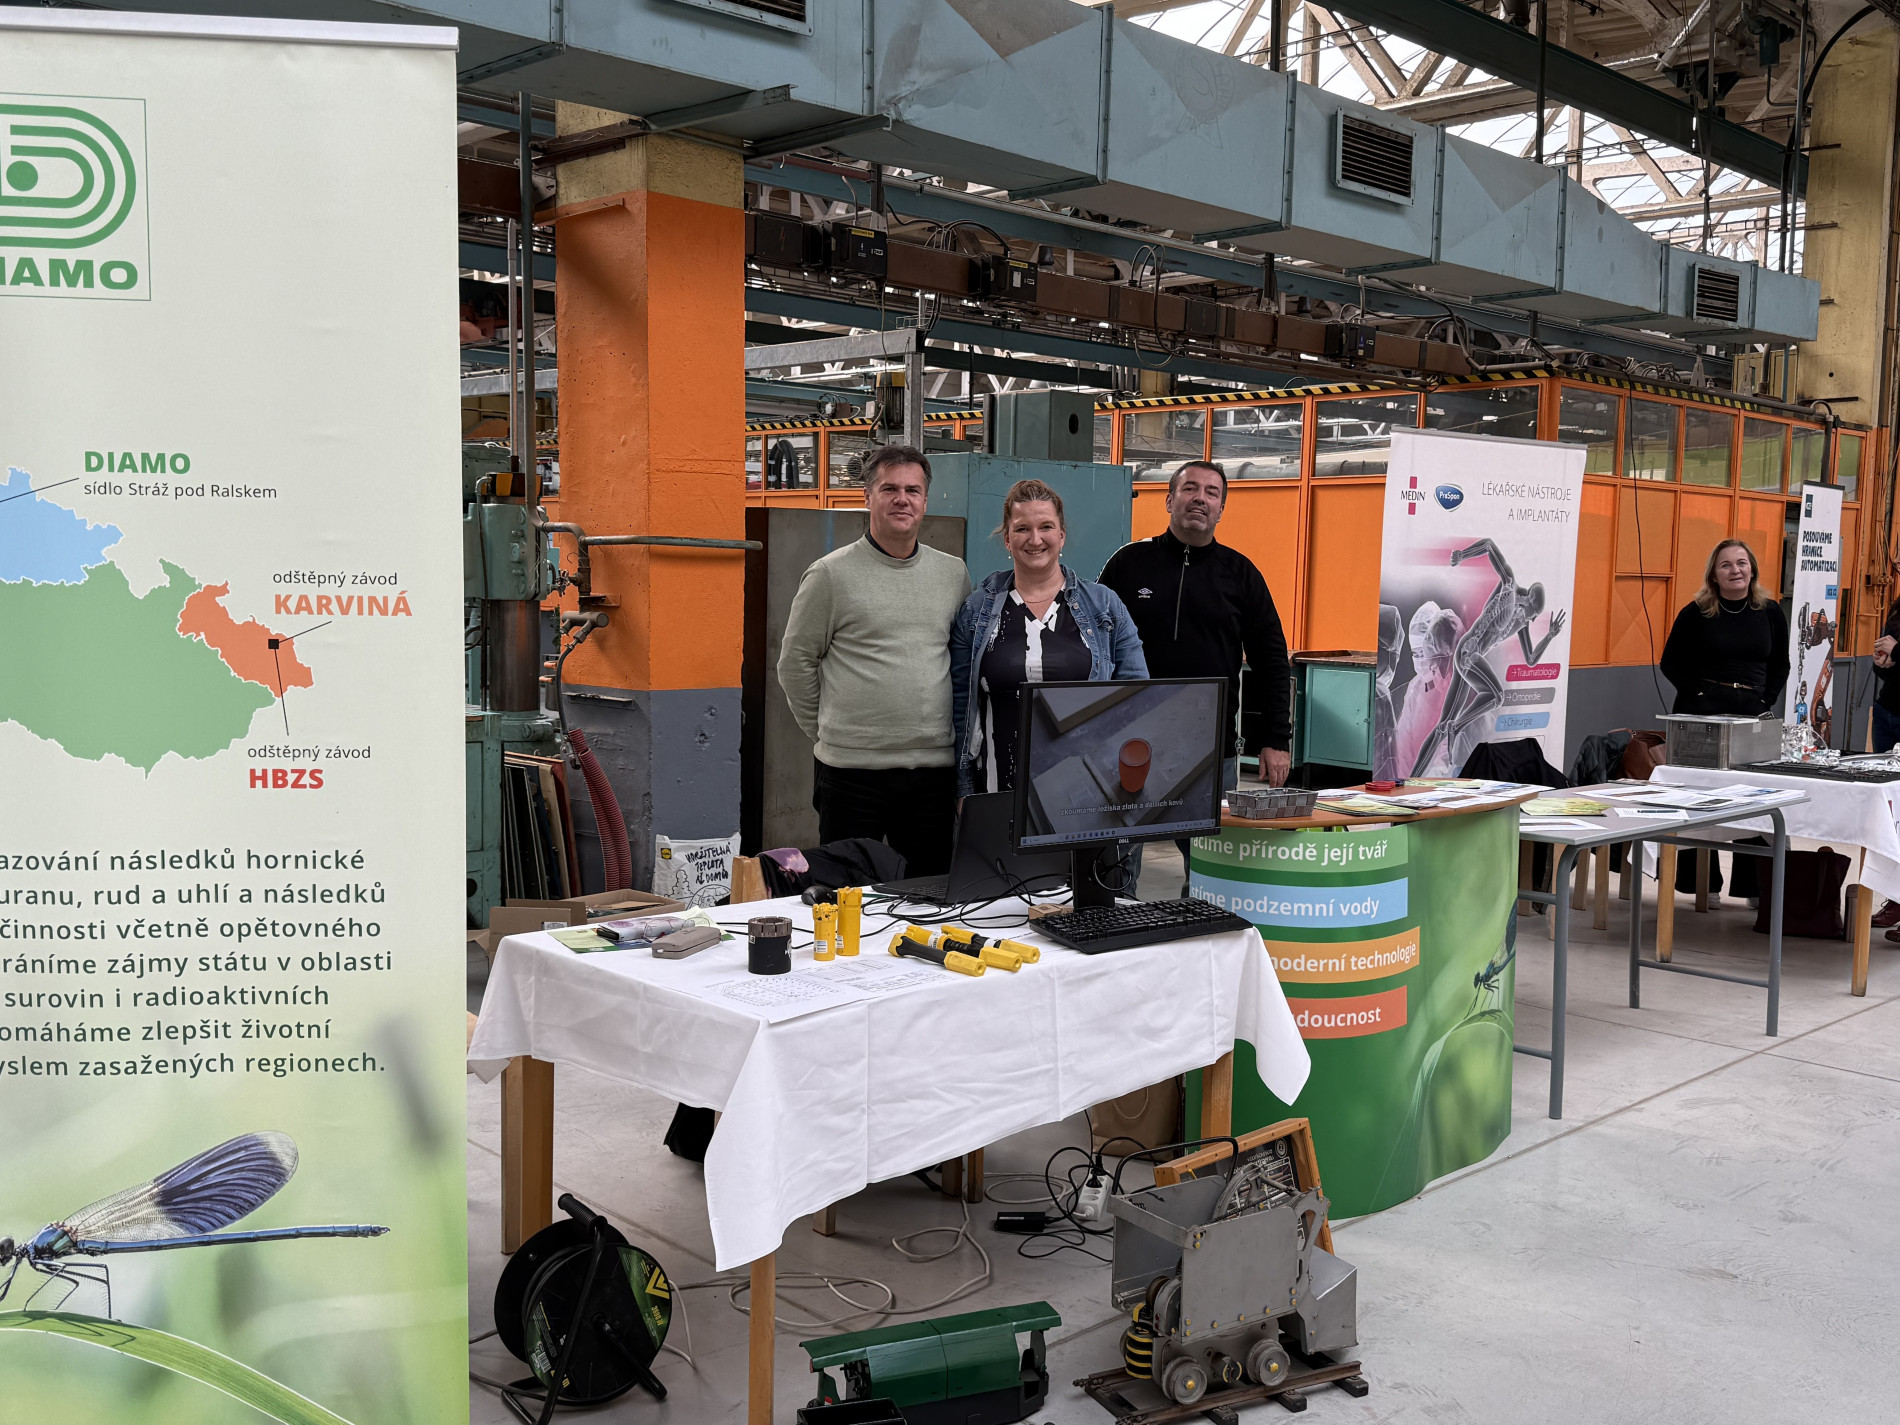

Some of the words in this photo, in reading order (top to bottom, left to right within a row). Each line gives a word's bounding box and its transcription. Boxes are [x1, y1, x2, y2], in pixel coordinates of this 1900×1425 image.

[85, 451, 190, 474] DIAMO
[84, 481, 122, 495] sídlo
[129, 483, 168, 496] Stráž
[175, 484, 204, 500] pod
[211, 484, 276, 498] Ralskem
[1401, 490, 1426, 501] MEDIN
[1482, 481, 1526, 498] LÉKAŘSKÉ
[1527, 485, 1571, 501] NÁSTROJE
[1508, 508, 1515, 520] A
[1516, 508, 1570, 523] IMPLANTÁTY
[273, 571, 346, 588] odštěpný
[352, 572, 397, 585] závod
[275, 590, 412, 616] KARVINÁ
[1516, 667, 1557, 678] Traumatologie
[248, 745, 320, 761] odštěpný
[326, 746, 370, 758] závod
[250, 769, 323, 789] HBZS
[111, 848, 234, 870] následků
[247, 849, 364, 869] hornické
[1239, 839, 1317, 861] přírodě
[1321, 842, 1353, 865] její
[1358, 840, 1388, 860] tvář
[95, 885, 139, 905] rud
[152, 890, 165, 904] a
[178, 883, 229, 903] uhlí
[239, 889, 251, 903] a
[265, 882, 384, 903] následků
[1231, 893, 1334, 917] podzemní
[1340, 897, 1380, 919] vody
[0, 919, 105, 939] činnosti
[116, 918, 208, 939] včetně
[220, 917, 380, 943] opětovného
[3, 954, 96, 974] ráníme
[108, 953, 188, 978] zájmy
[199, 952, 266, 971] státu
[277, 957, 290, 971] v
[301, 951, 391, 971] oblasti
[1351, 941, 1416, 972] technologie
[5, 989, 103, 1008] surovin
[116, 988, 120, 1007] i
[134, 985, 328, 1007] radioaktivních
[1297, 1007, 1381, 1028] doucnost
[142, 1019, 231, 1045] zlepšit
[242, 1019, 331, 1038] životní
[79, 1053, 233, 1078] zasažených
[246, 1052, 384, 1077] regionech.
